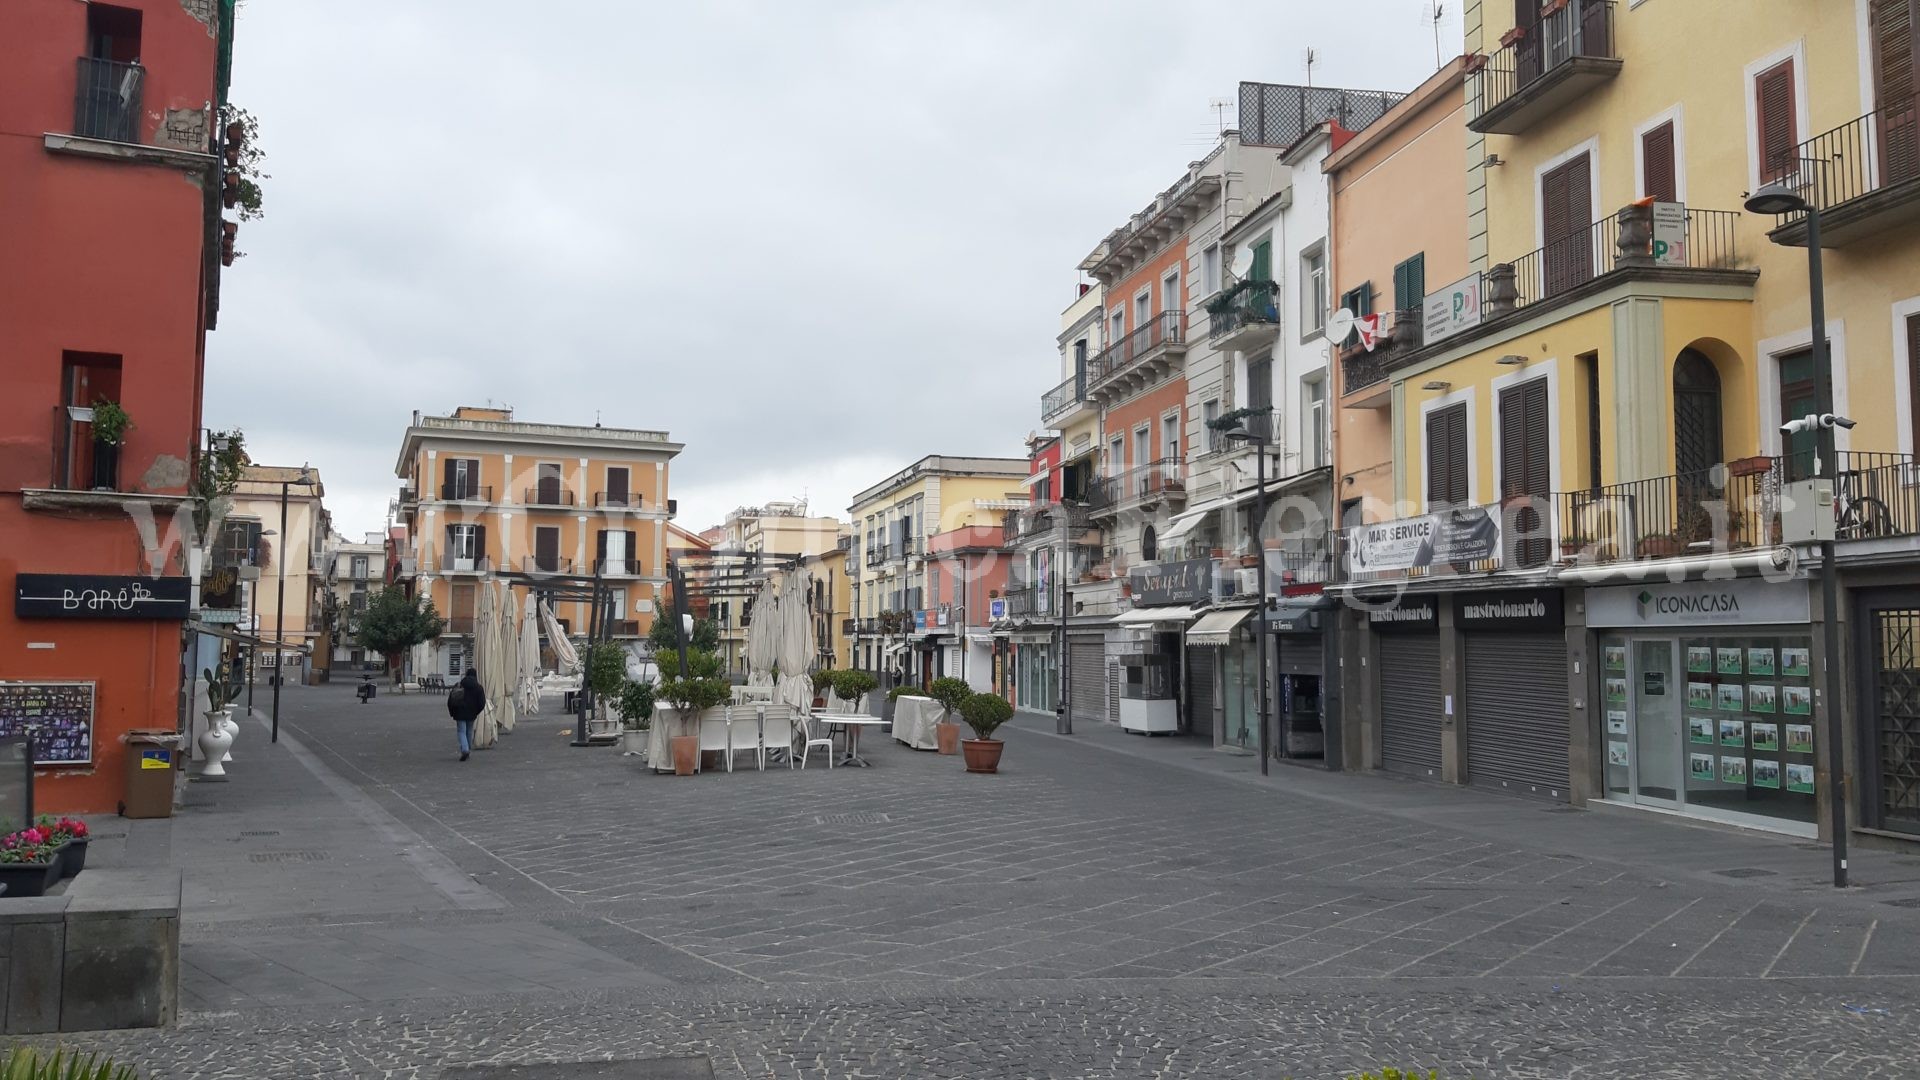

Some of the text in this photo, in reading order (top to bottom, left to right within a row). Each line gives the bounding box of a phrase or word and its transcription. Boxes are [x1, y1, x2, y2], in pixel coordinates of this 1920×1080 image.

[1368, 528, 1388, 543] MAR
[1390, 522, 1430, 541] SERVICE
[1463, 598, 1546, 619] mastrolonardo
[1655, 594, 1740, 613] ICONACASA
